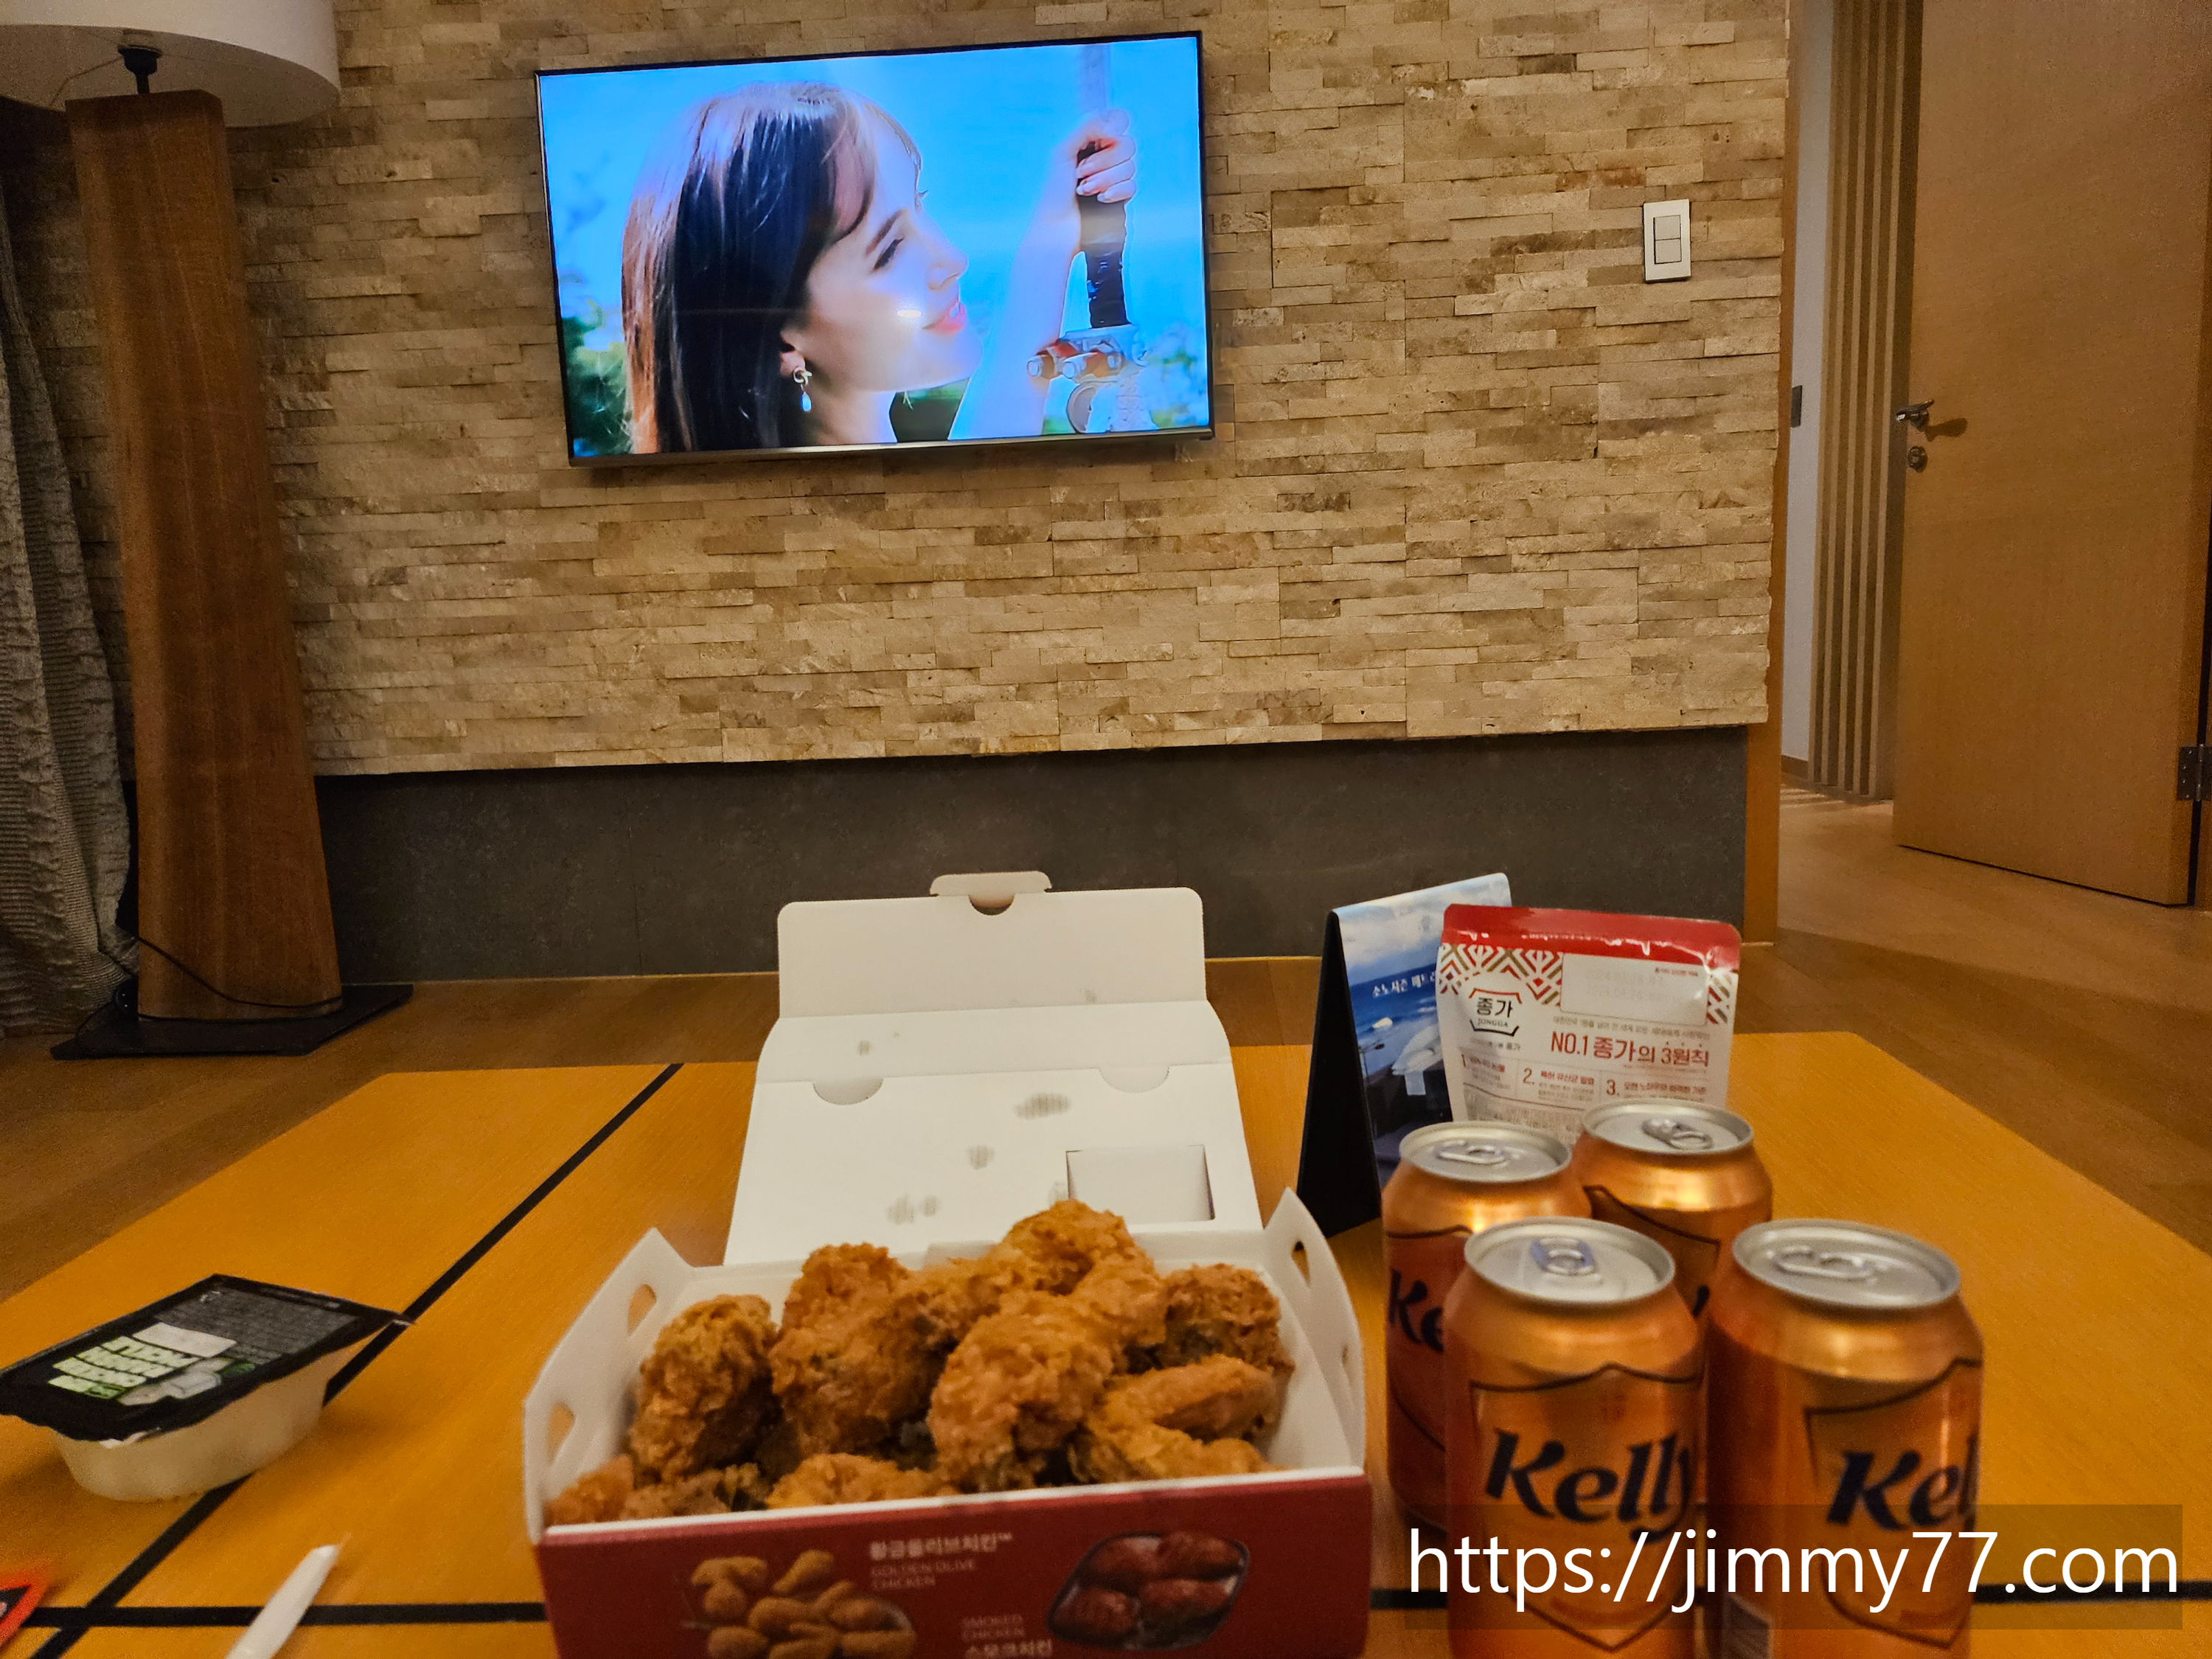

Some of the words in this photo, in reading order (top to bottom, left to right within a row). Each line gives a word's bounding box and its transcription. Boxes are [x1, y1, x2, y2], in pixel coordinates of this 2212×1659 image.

[1477, 997, 1513, 1018] 종가
[1477, 1018, 1509, 1028] JONGGA
[1551, 1031, 1588, 1056] NO.1
[1593, 1036, 1655, 1062] 종가의
[1660, 1047, 1709, 1067] 3원칙
[1523, 1068, 1534, 1085] 2.
[1606, 1079, 1620, 1096] 3.
[936, 1558, 975, 1573] OLIVE
[872, 1576, 935, 1589] CHICKEN
